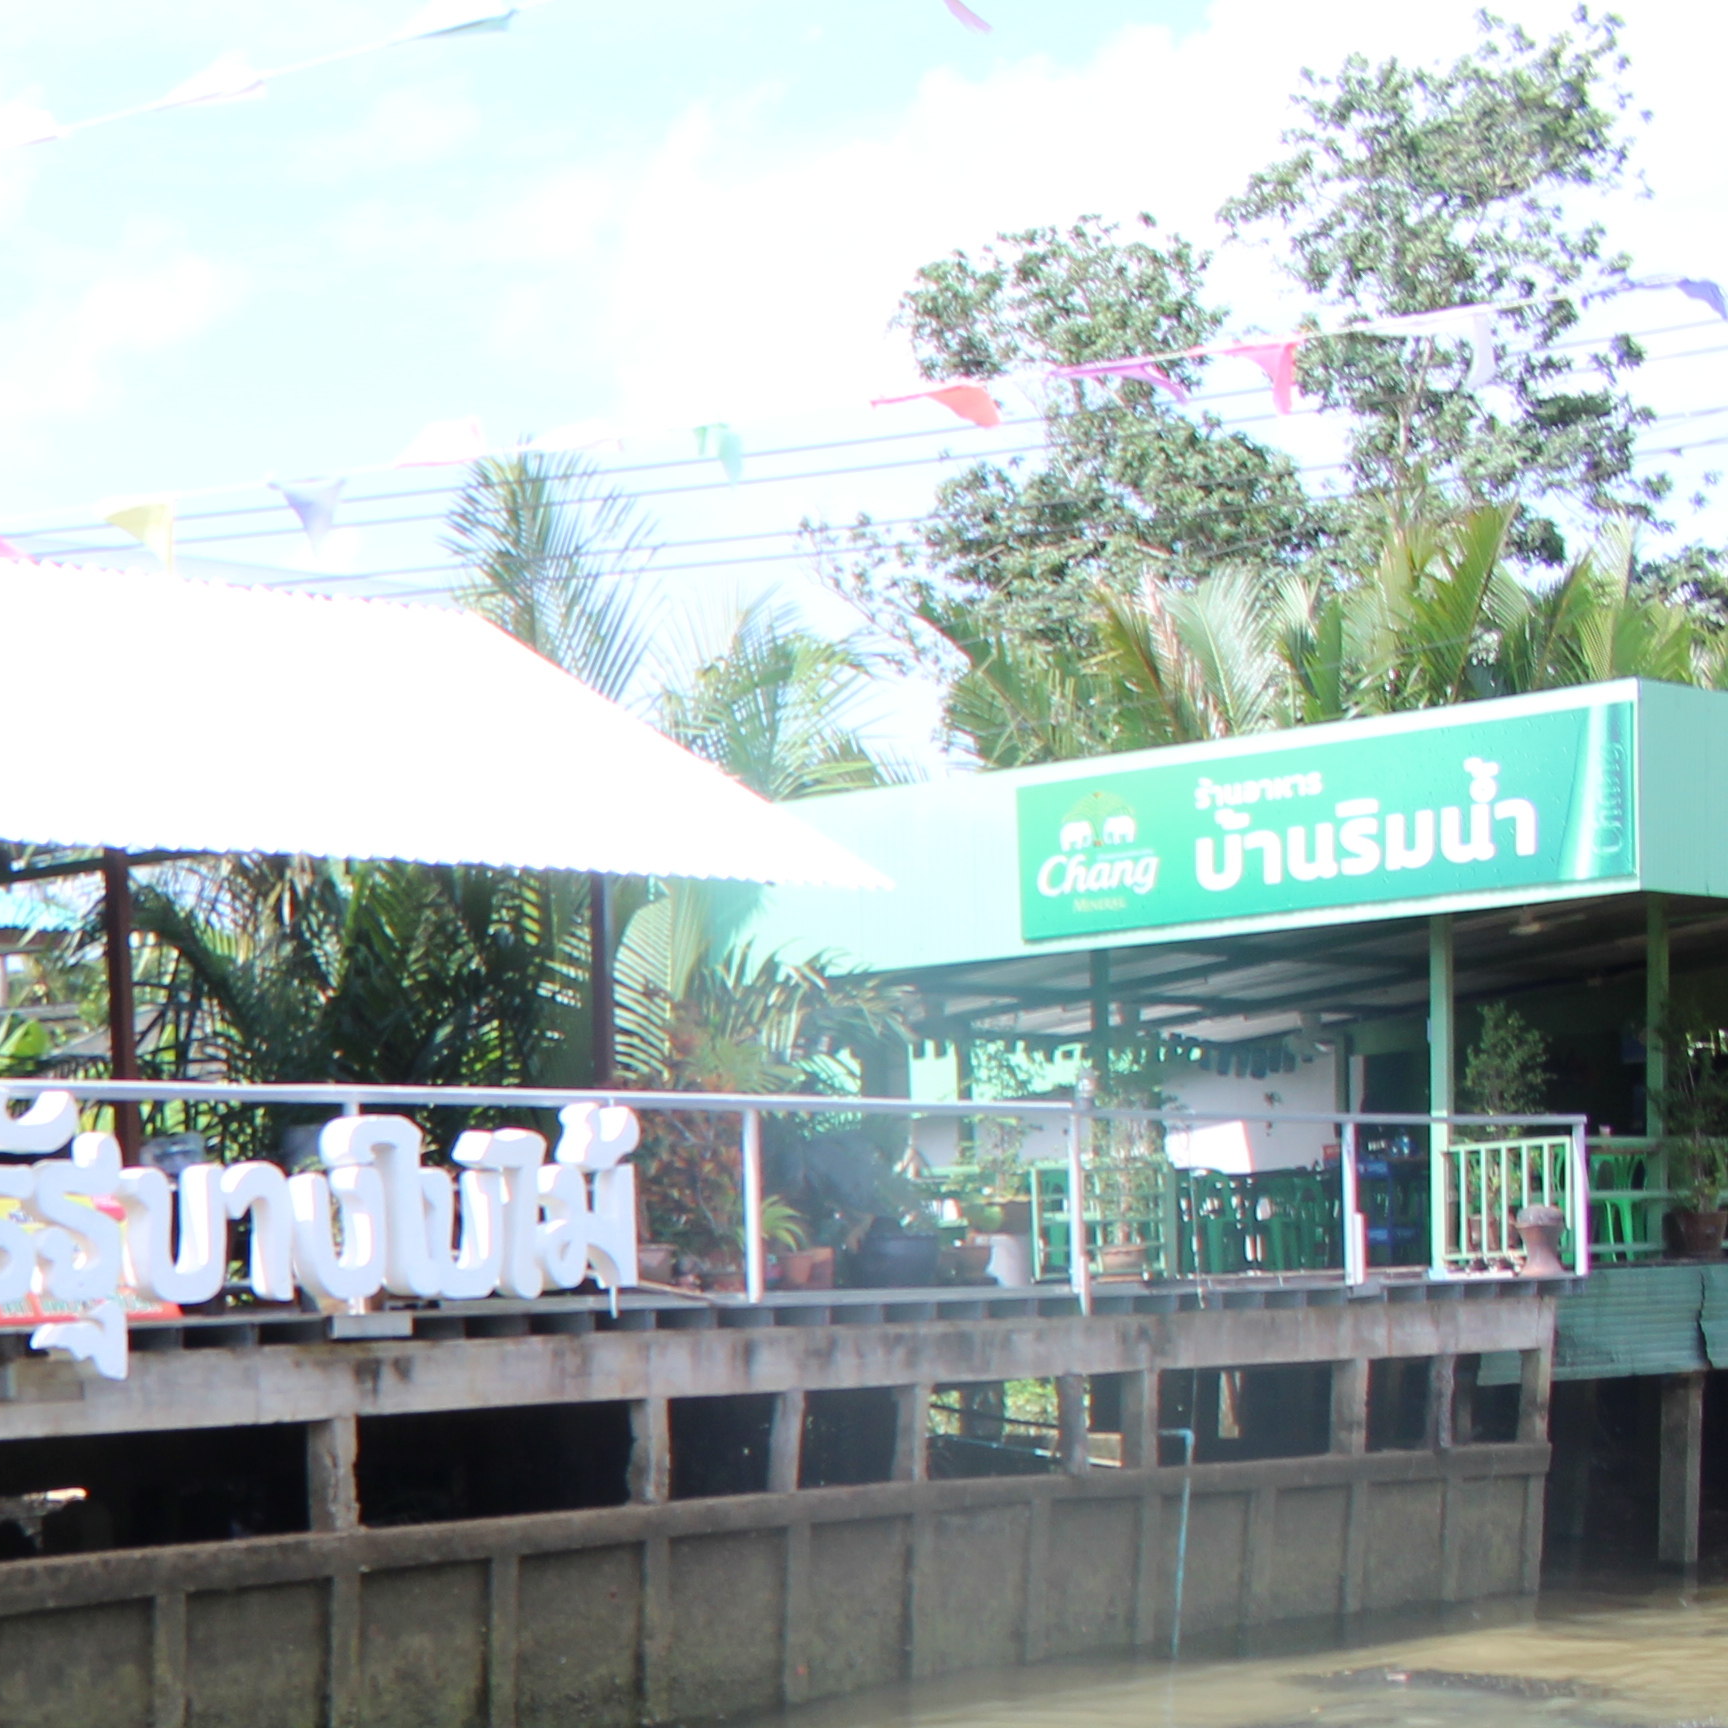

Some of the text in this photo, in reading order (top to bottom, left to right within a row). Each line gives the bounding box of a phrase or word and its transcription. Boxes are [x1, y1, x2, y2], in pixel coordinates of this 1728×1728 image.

[1194, 770, 1323, 811] ร้านอาหาร
[1194, 758, 1539, 892] บ้านริมน้ำ
[1036, 853, 1160, 898] Chang
